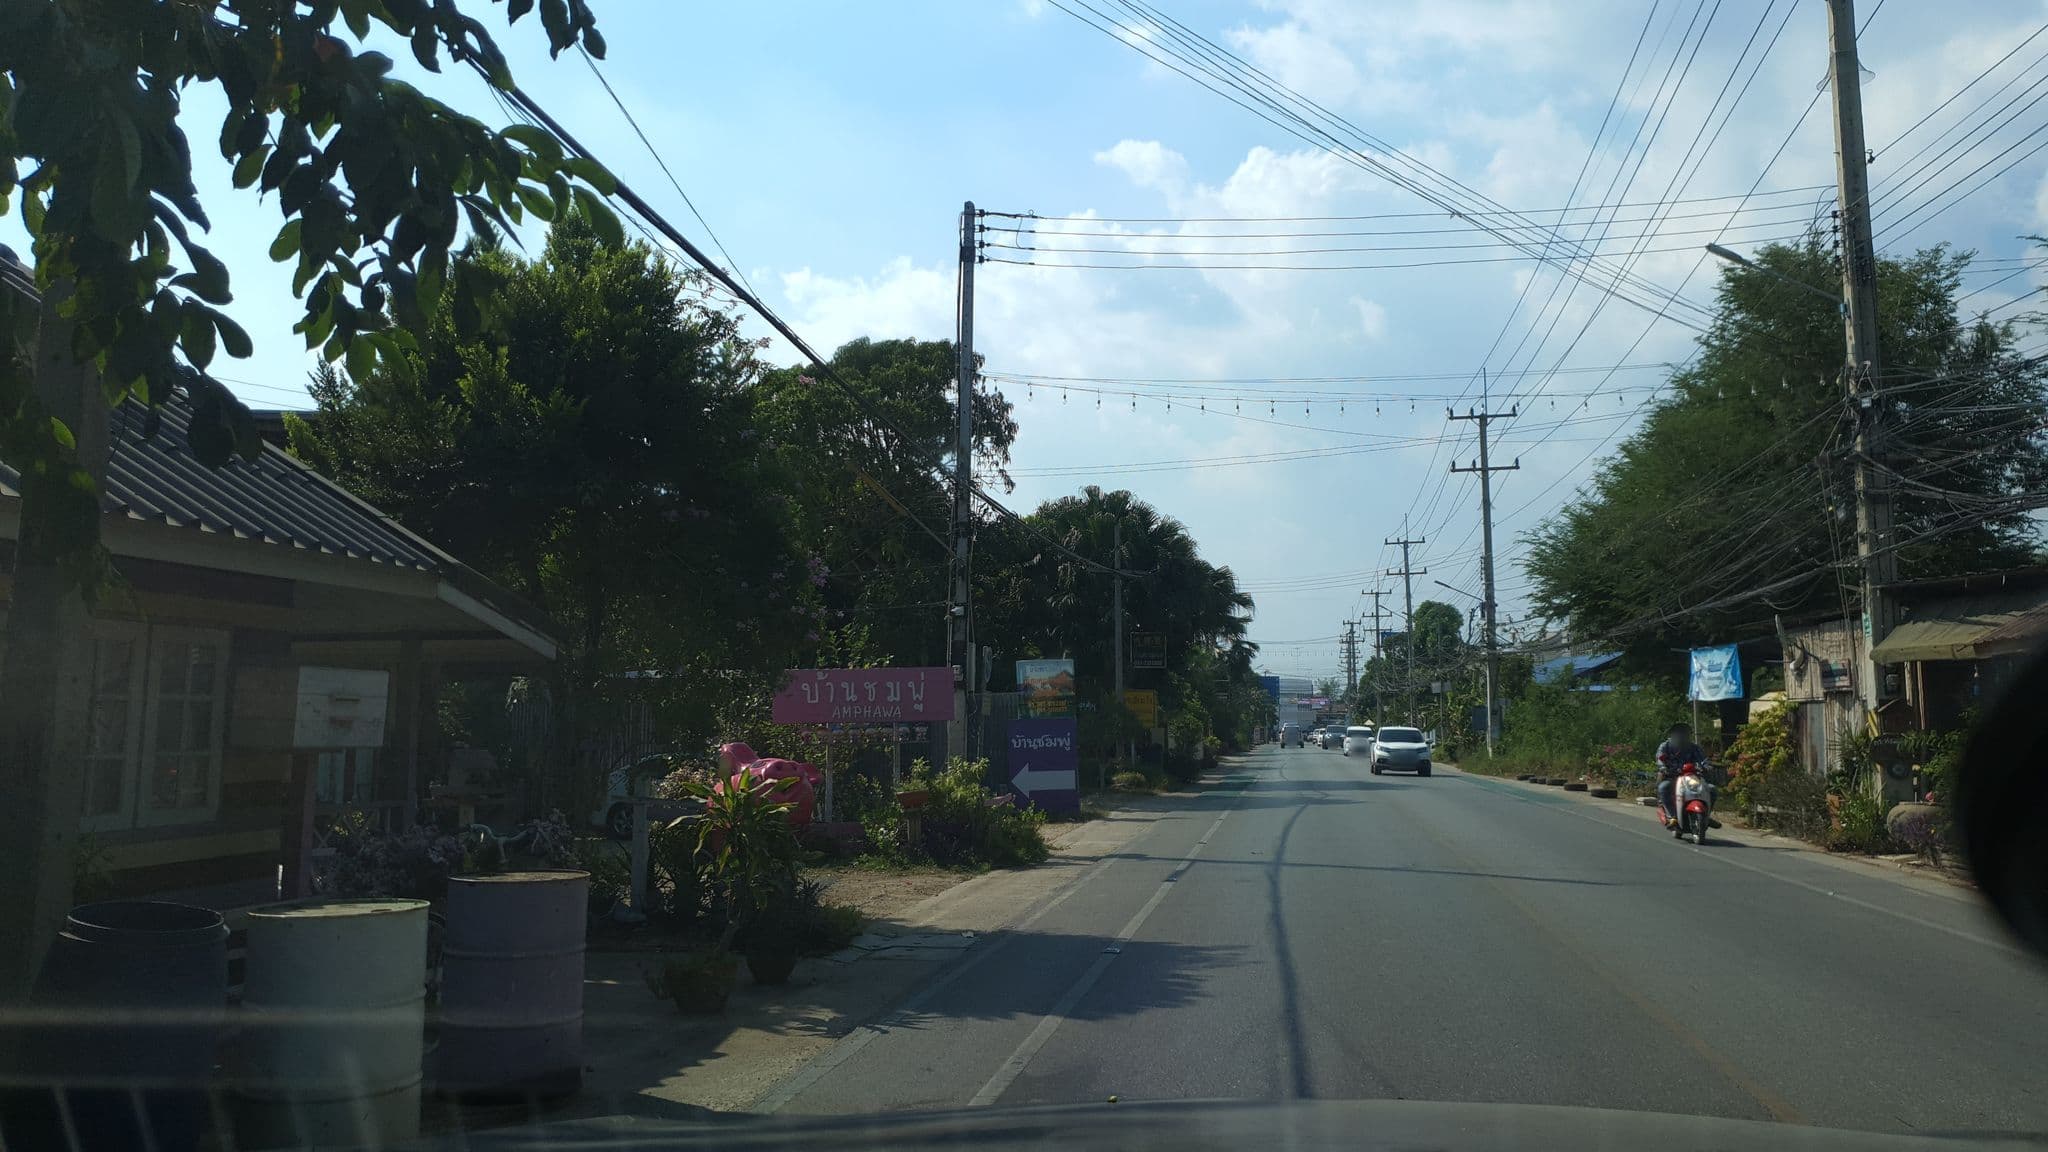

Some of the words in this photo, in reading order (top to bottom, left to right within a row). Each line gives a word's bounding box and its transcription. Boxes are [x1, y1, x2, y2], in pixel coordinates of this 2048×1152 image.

[801, 671, 926, 712] บ้านชมพู่
[831, 705, 902, 719] AMPHAWA
